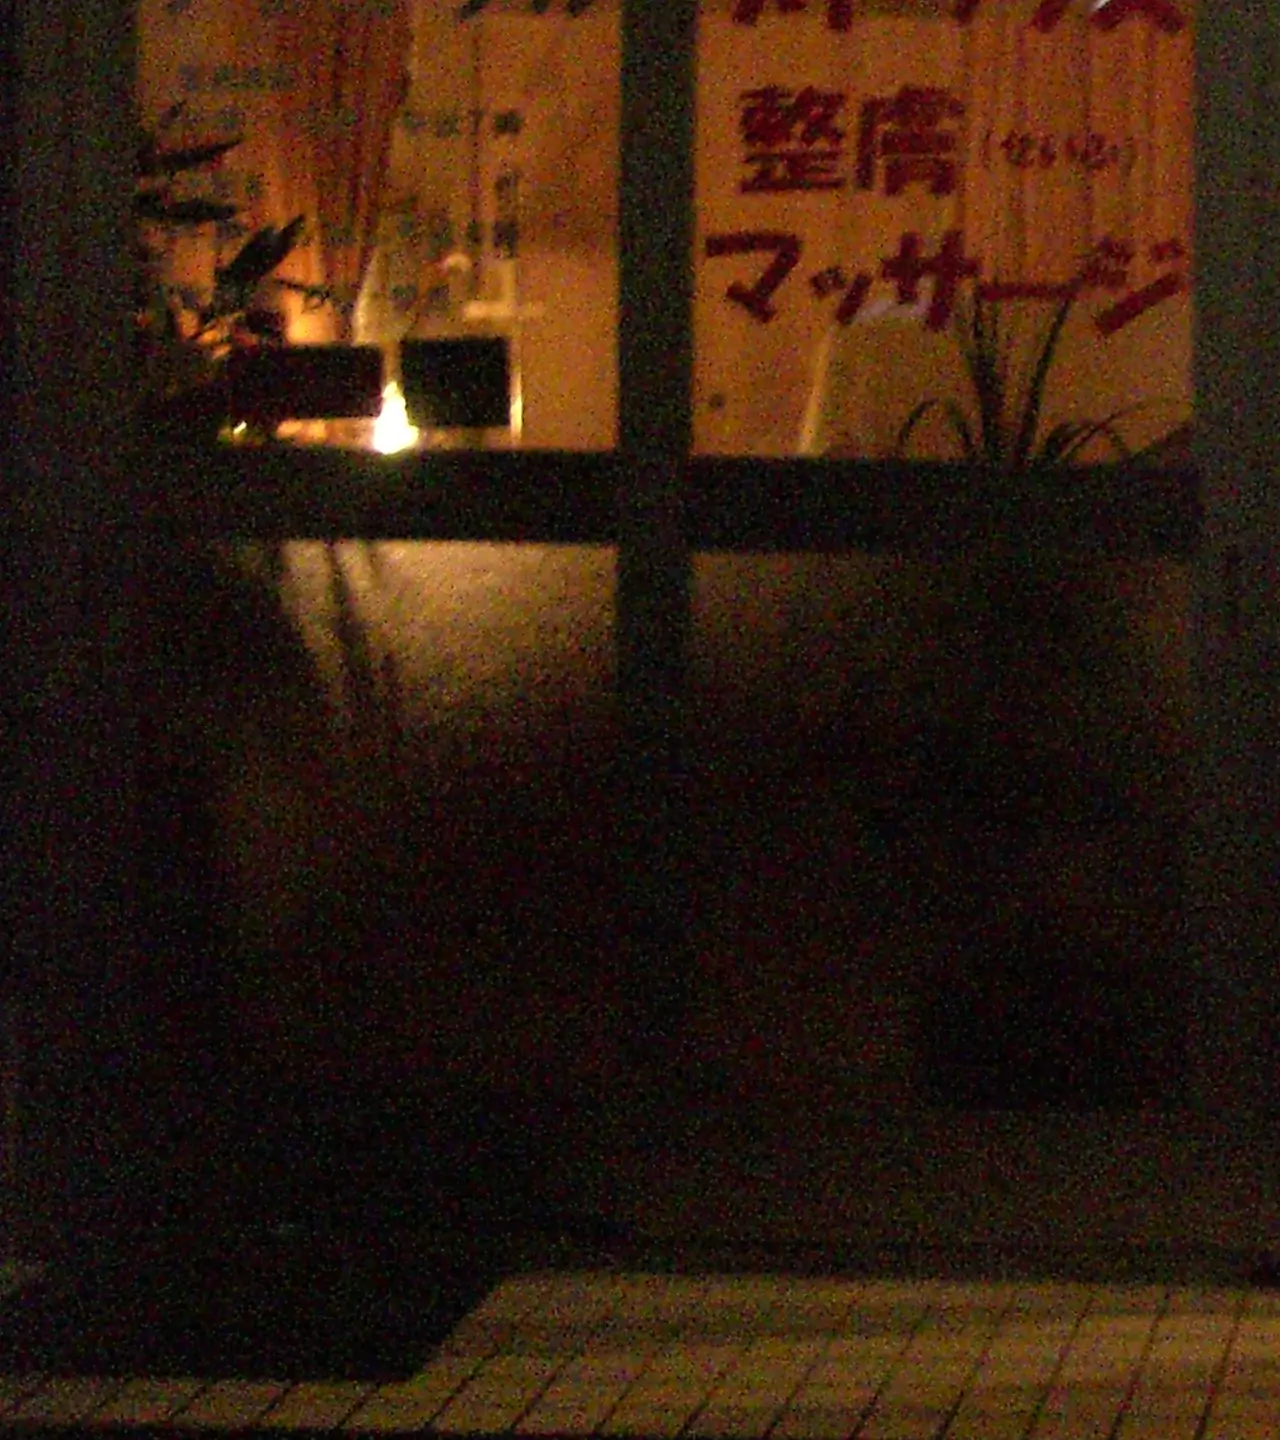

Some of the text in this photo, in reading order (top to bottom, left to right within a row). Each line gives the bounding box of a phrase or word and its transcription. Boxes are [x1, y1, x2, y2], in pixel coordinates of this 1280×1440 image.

[705, 231, 1185, 336] マッサージ
